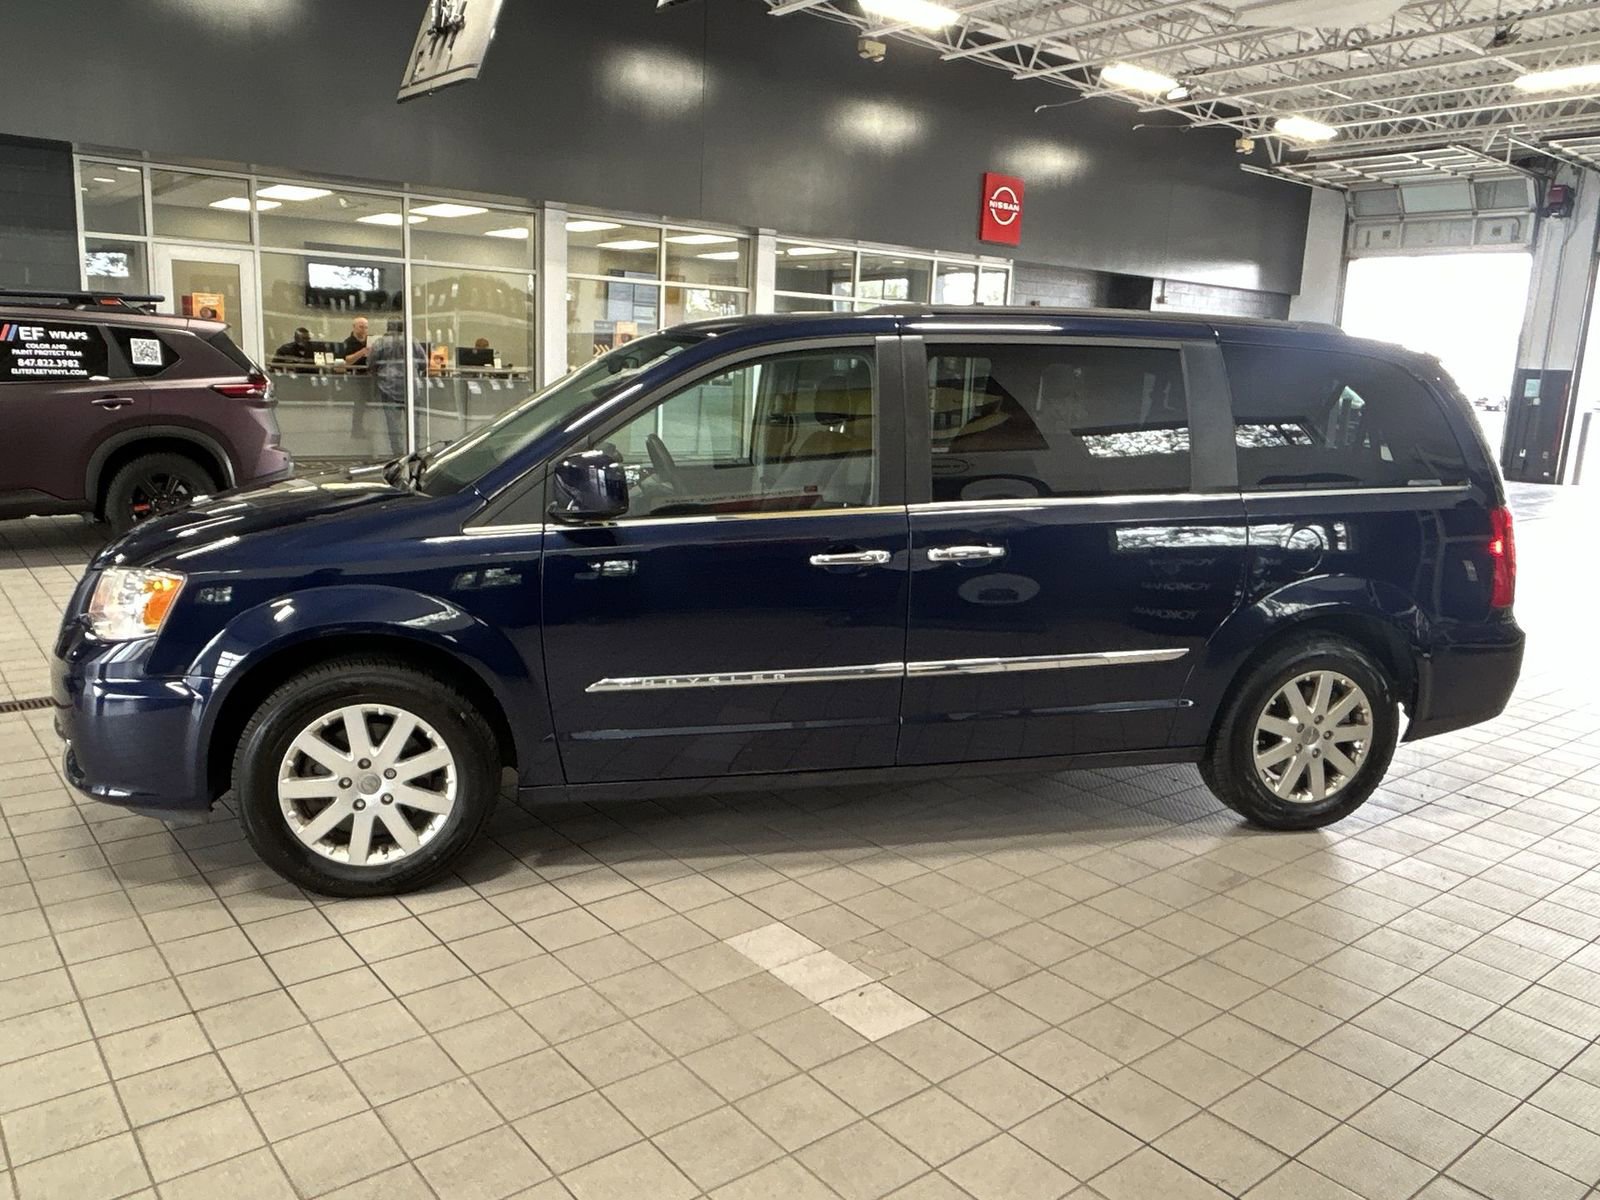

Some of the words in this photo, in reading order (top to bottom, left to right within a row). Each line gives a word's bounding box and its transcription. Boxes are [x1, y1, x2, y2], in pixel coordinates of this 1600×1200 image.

[989, 200, 1019, 212] NISSAN
[18, 326, 45, 341] EF
[48, 330, 89, 341] WRAPS
[17, 358, 80, 368] 847.822.3982
[11, 367, 88, 376] ELITEFLEETVINYL.COM
